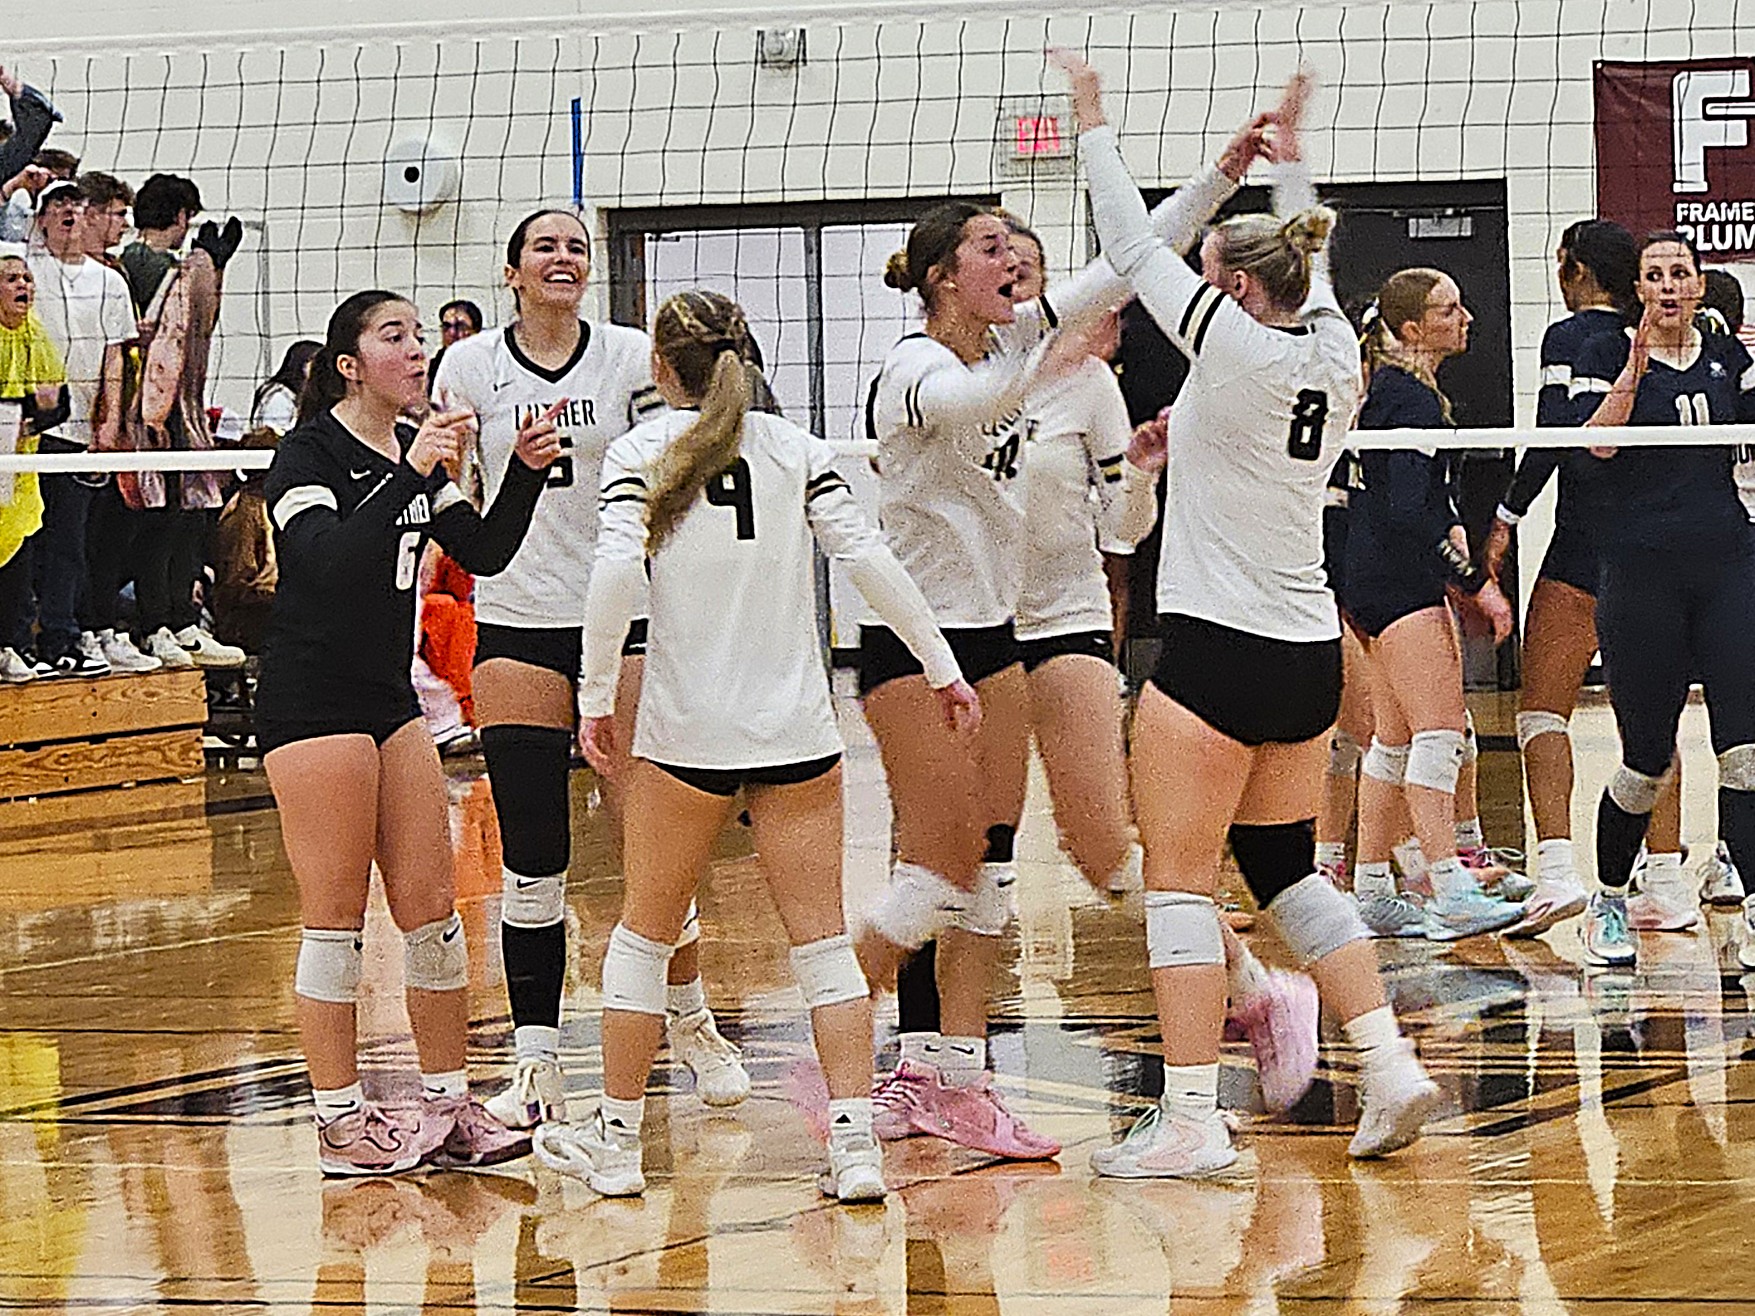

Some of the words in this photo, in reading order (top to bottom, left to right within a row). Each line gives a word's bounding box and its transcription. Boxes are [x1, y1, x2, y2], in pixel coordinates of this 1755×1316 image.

[1017, 116, 1060, 154] EXIT
[514, 398, 596, 432] LHER
[1675, 392, 1710, 426] 11
